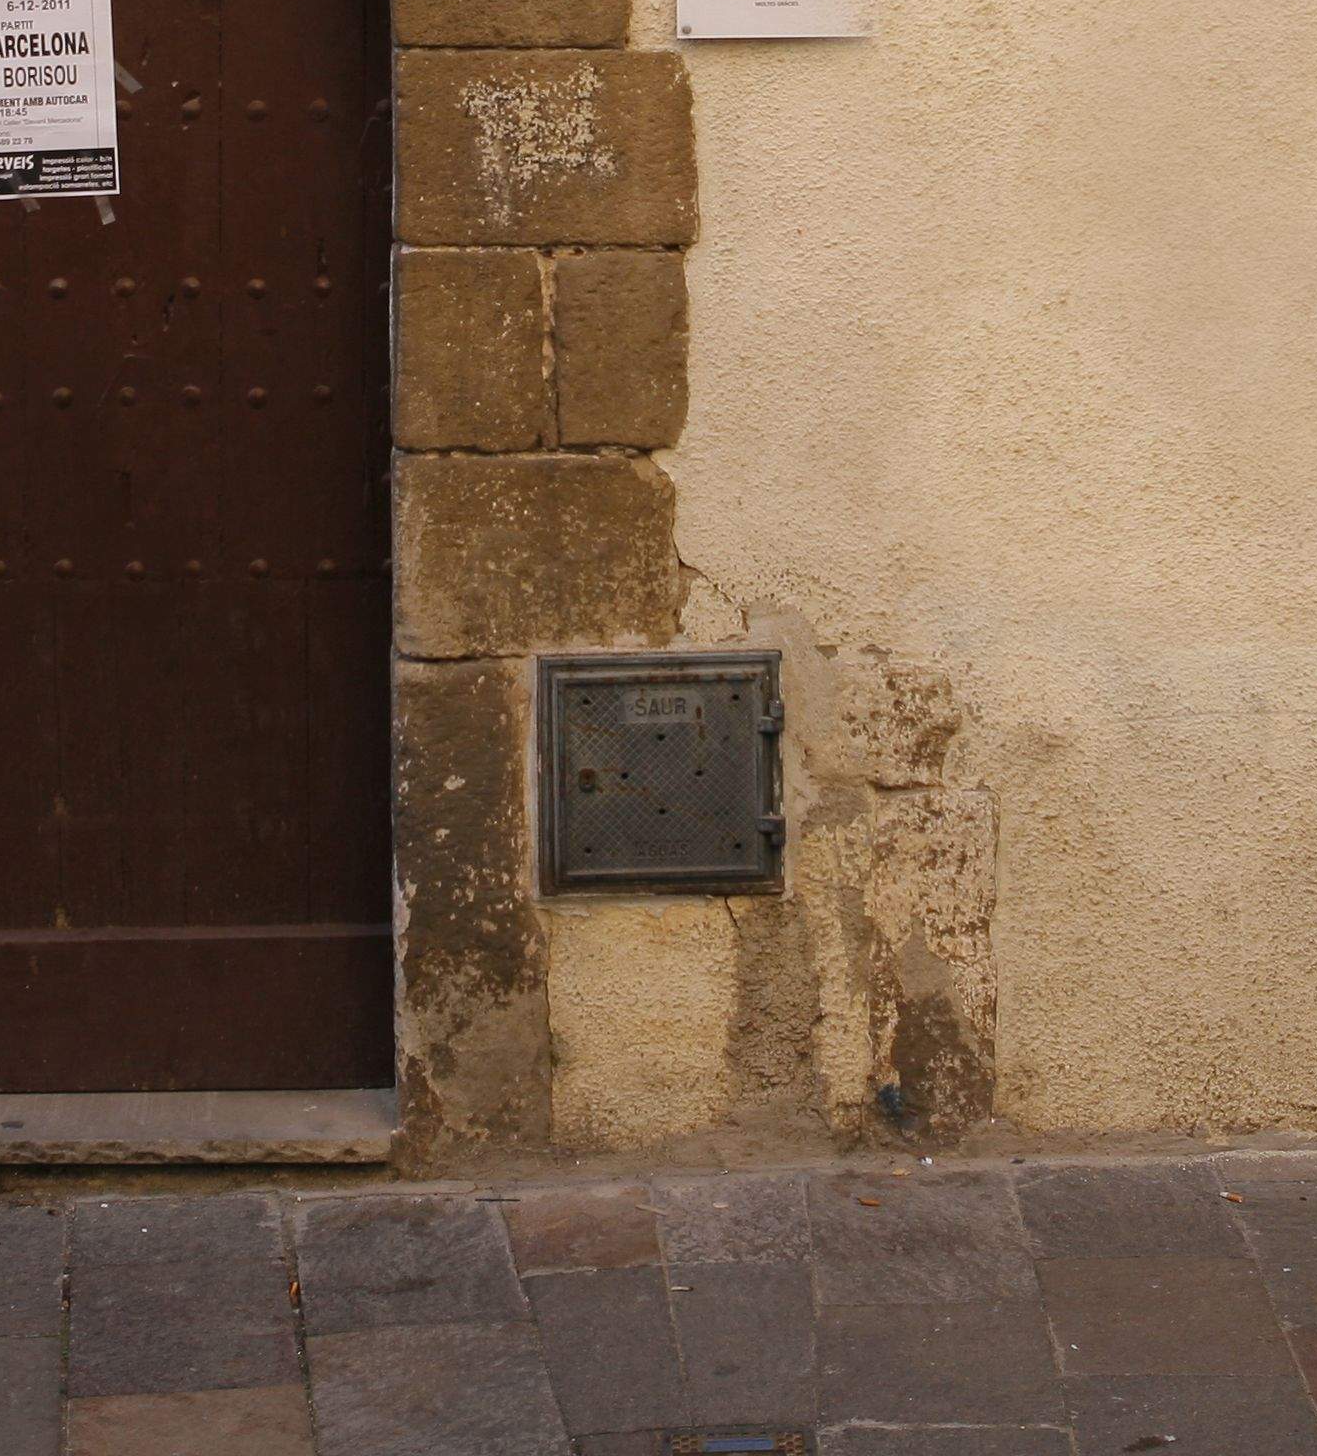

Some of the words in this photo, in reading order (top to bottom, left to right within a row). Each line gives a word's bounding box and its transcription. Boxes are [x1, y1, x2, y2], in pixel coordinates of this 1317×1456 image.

[0, 20, 34, 31] PARTIT
[3, 64, 77, 88] BORISOU
[23, 96, 43, 106] AMB
[46, 94, 89, 105] AUTOCAR
[0, 108, 28, 118] 18:45
[634, 697, 687, 717] SAUR
